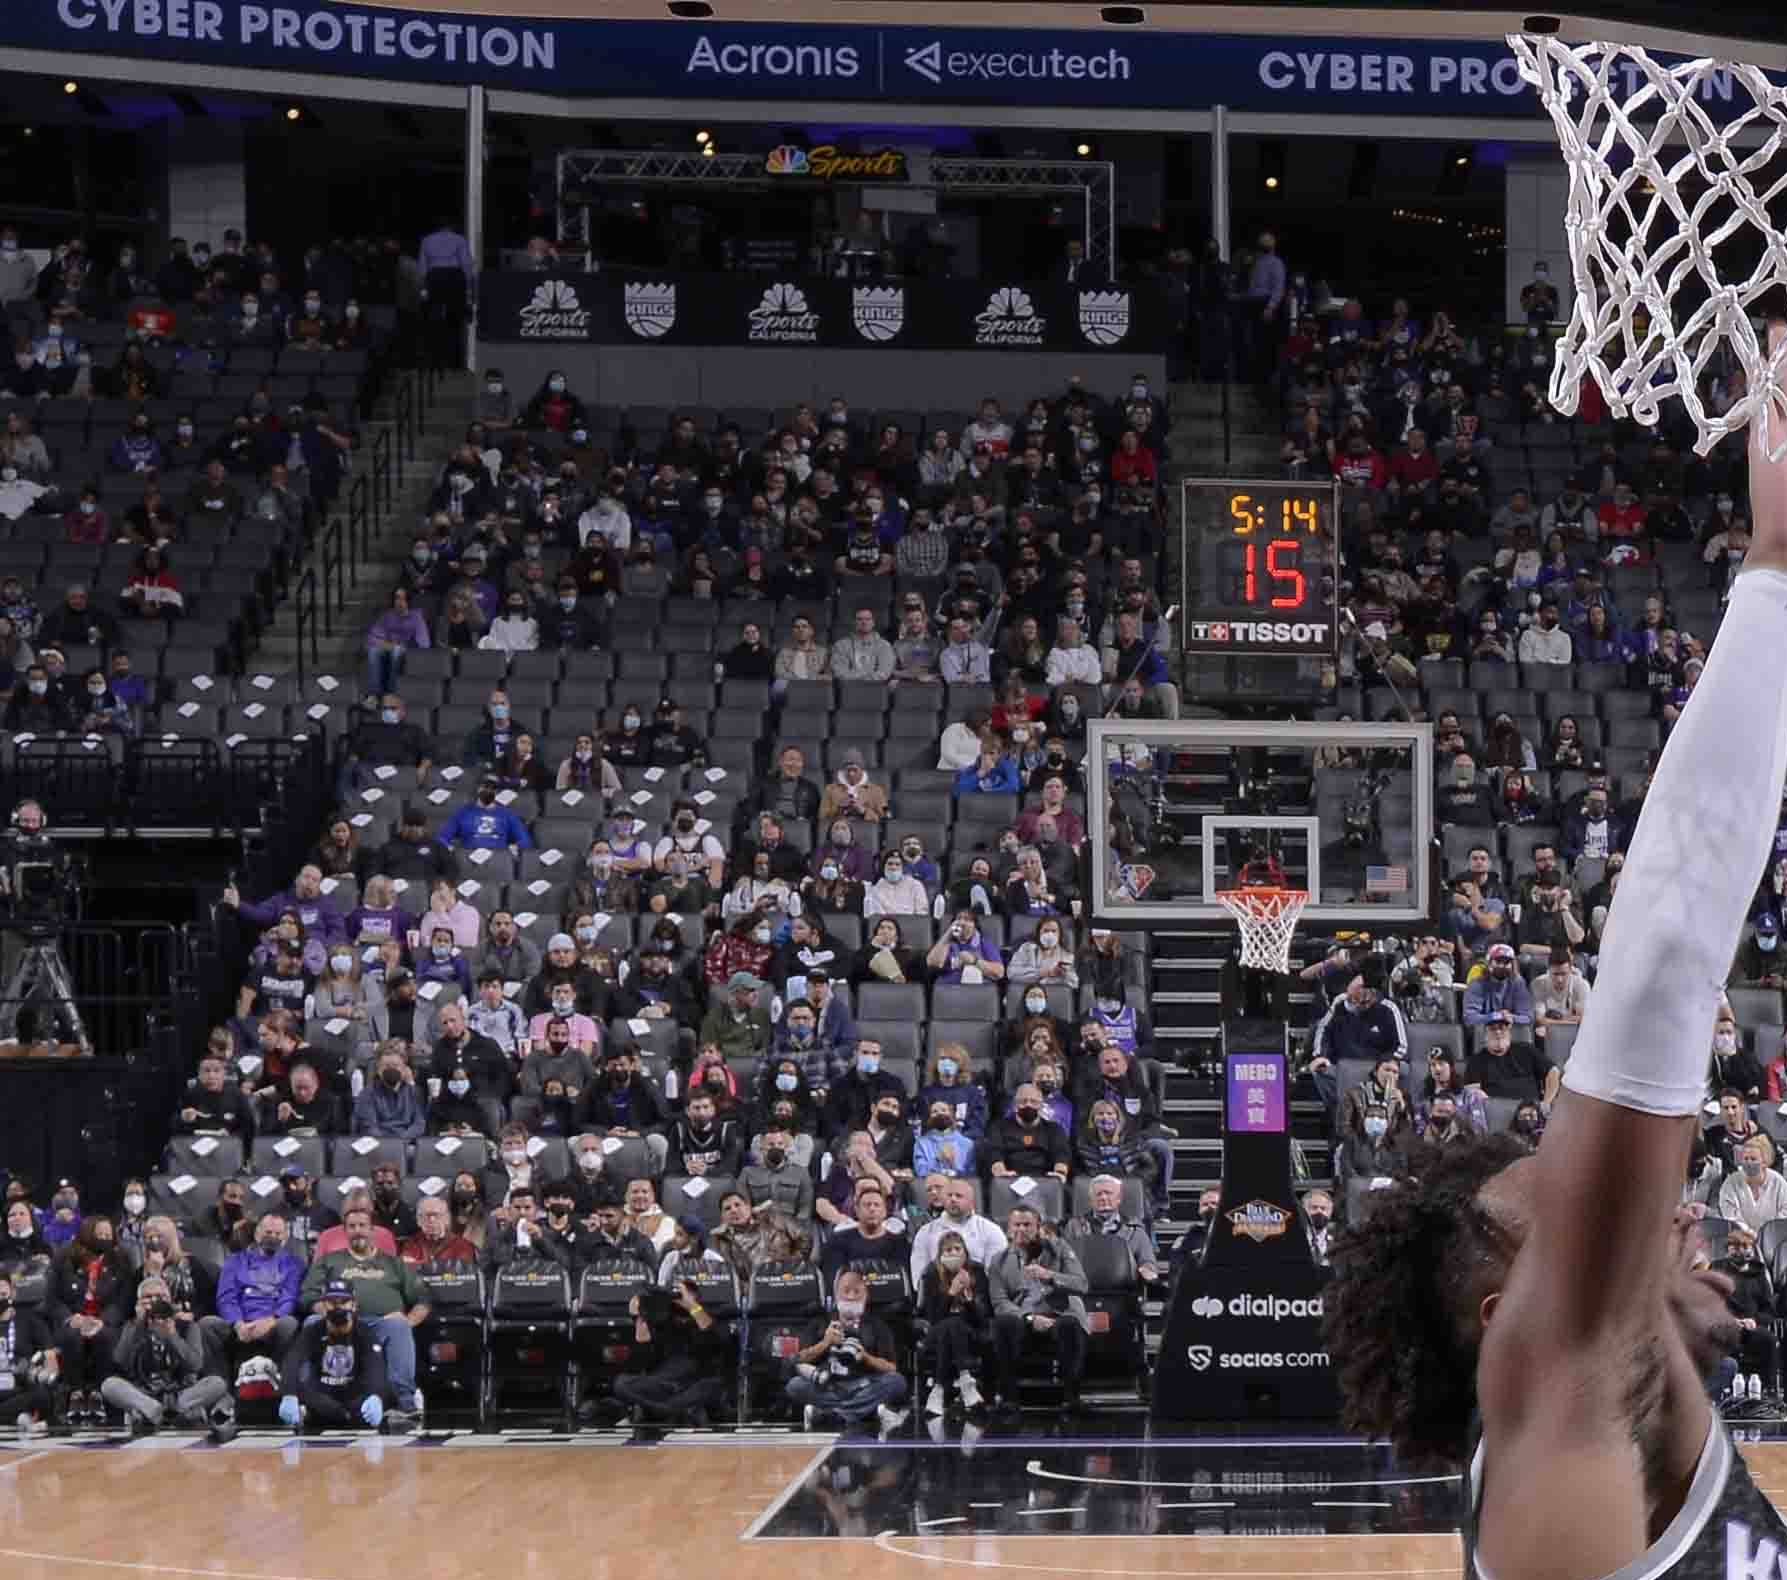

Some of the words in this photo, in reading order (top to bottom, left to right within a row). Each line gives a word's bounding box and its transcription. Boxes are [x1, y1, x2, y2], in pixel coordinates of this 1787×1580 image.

[57, 0, 223, 41] CYBER
[241, 11, 556, 69] PROTECTION
[687, 36, 859, 76] Acronis
[948, 47, 1130, 79] executech
[1258, 51, 1415, 92] CYBER
[1430, 56, 1735, 100] PROCTN
[808, 147, 899, 178] Sports
[854, 307, 903, 320] KINGS
[1079, 311, 1129, 324] KINGS
[1231, 495, 1317, 534] 5:14
[1244, 540, 1305, 608] 15
[1232, 622, 1329, 643] TISSOT
[1228, 1294, 1324, 1320] dialpad
